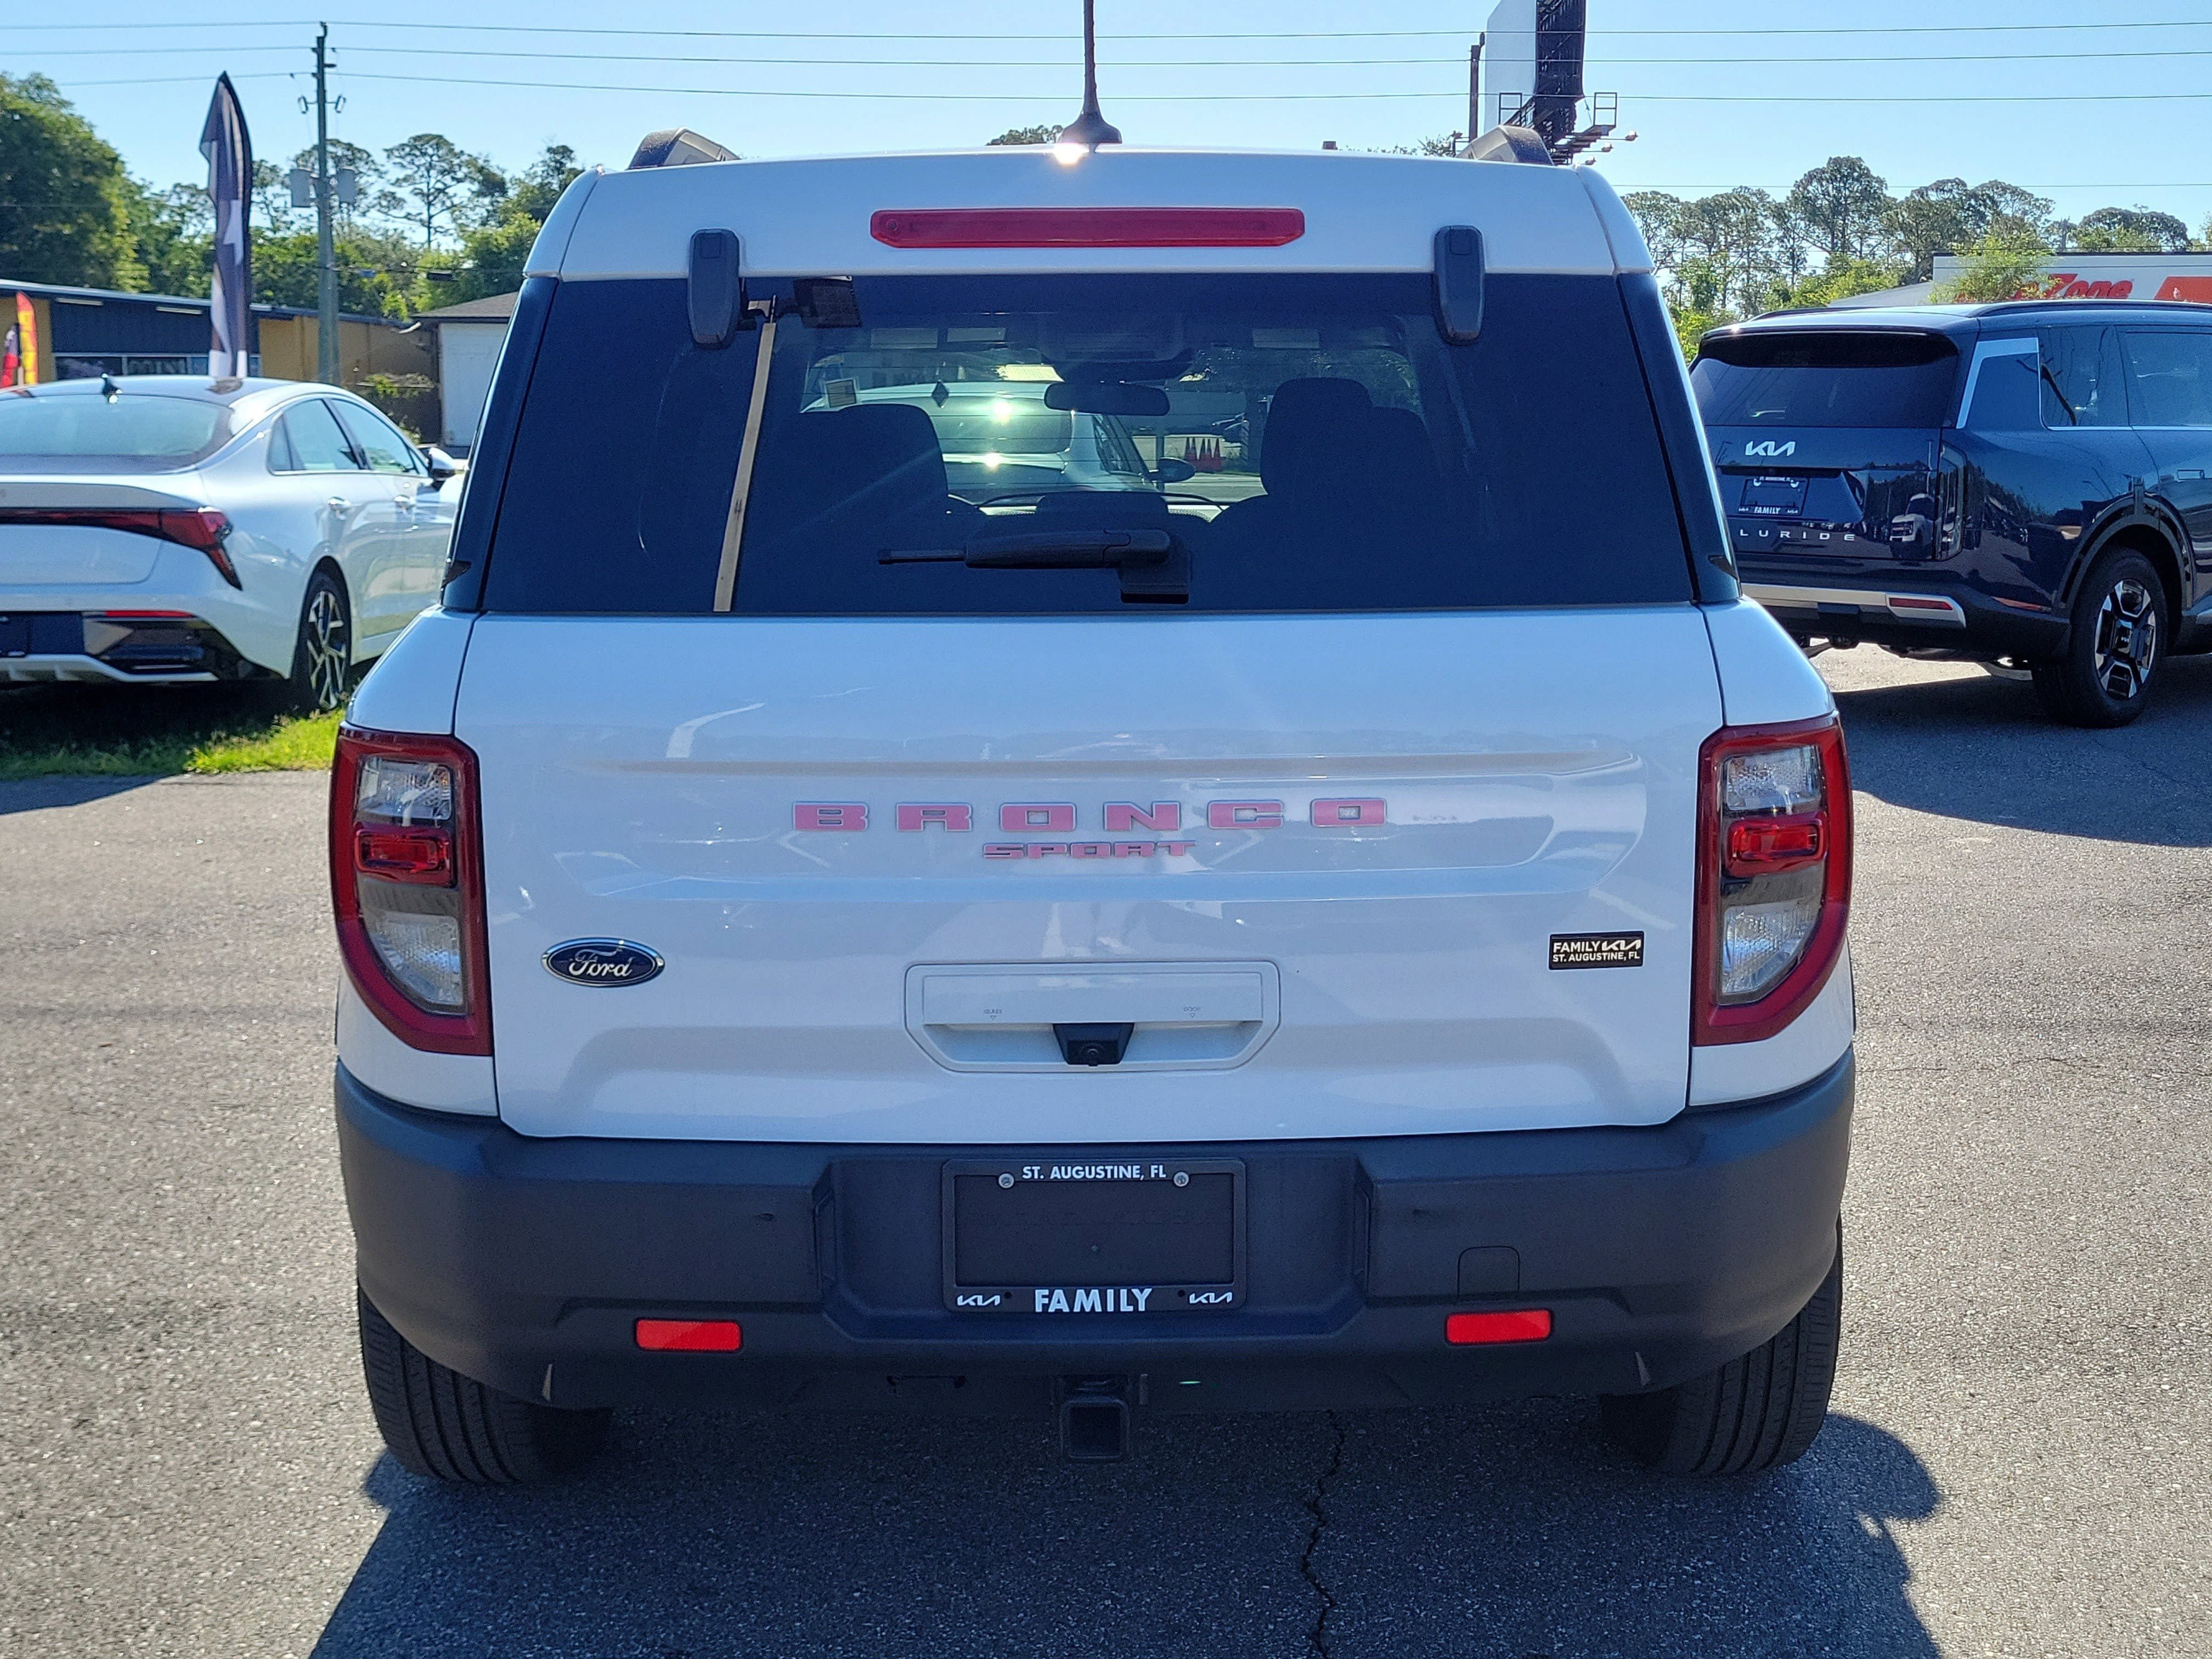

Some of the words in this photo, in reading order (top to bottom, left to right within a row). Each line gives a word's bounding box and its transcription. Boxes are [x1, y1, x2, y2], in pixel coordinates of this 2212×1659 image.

[1745, 441, 1796, 456] KIA
[1740, 529, 1856, 541] LURIDE
[793, 798, 1386, 832] BRONCO
[983, 841, 1197, 859] SPORT
[1553, 940, 1601, 953] FAMILY
[568, 949, 635, 977] Ford
[1553, 954, 1567, 962] ST.
[1568, 952, 1627, 962] AUGUSTINE,
[1628, 951, 1640, 960] FL
[1022, 1165, 1044, 1180] ST.
[1050, 1165, 1144, 1181] AUGUSTINE,
[1150, 1165, 1166, 1178] FL
[1035, 1288, 1152, 1312] FAMILY
